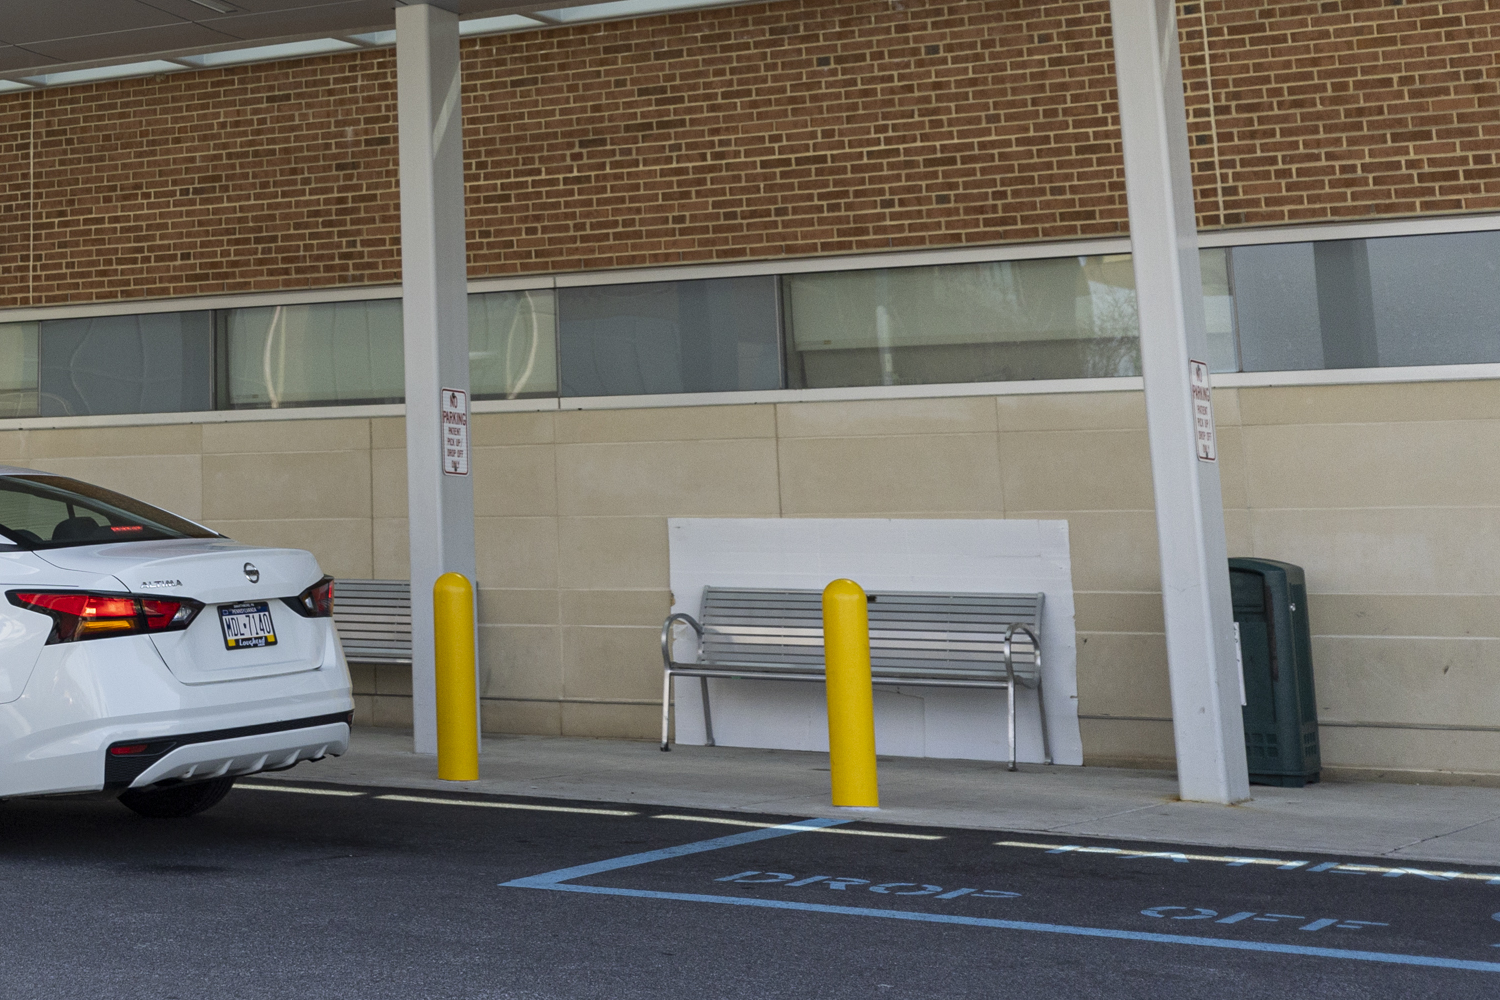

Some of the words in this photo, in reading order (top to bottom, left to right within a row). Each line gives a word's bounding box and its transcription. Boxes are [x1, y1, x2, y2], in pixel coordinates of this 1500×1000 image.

[449, 394, 458, 408] NO
[443, 411, 467, 426] PARKING
[140, 579, 183, 589] ALTIMA
[713, 870, 1023, 900] DROP
[1140, 905, 1389, 932] OFF
